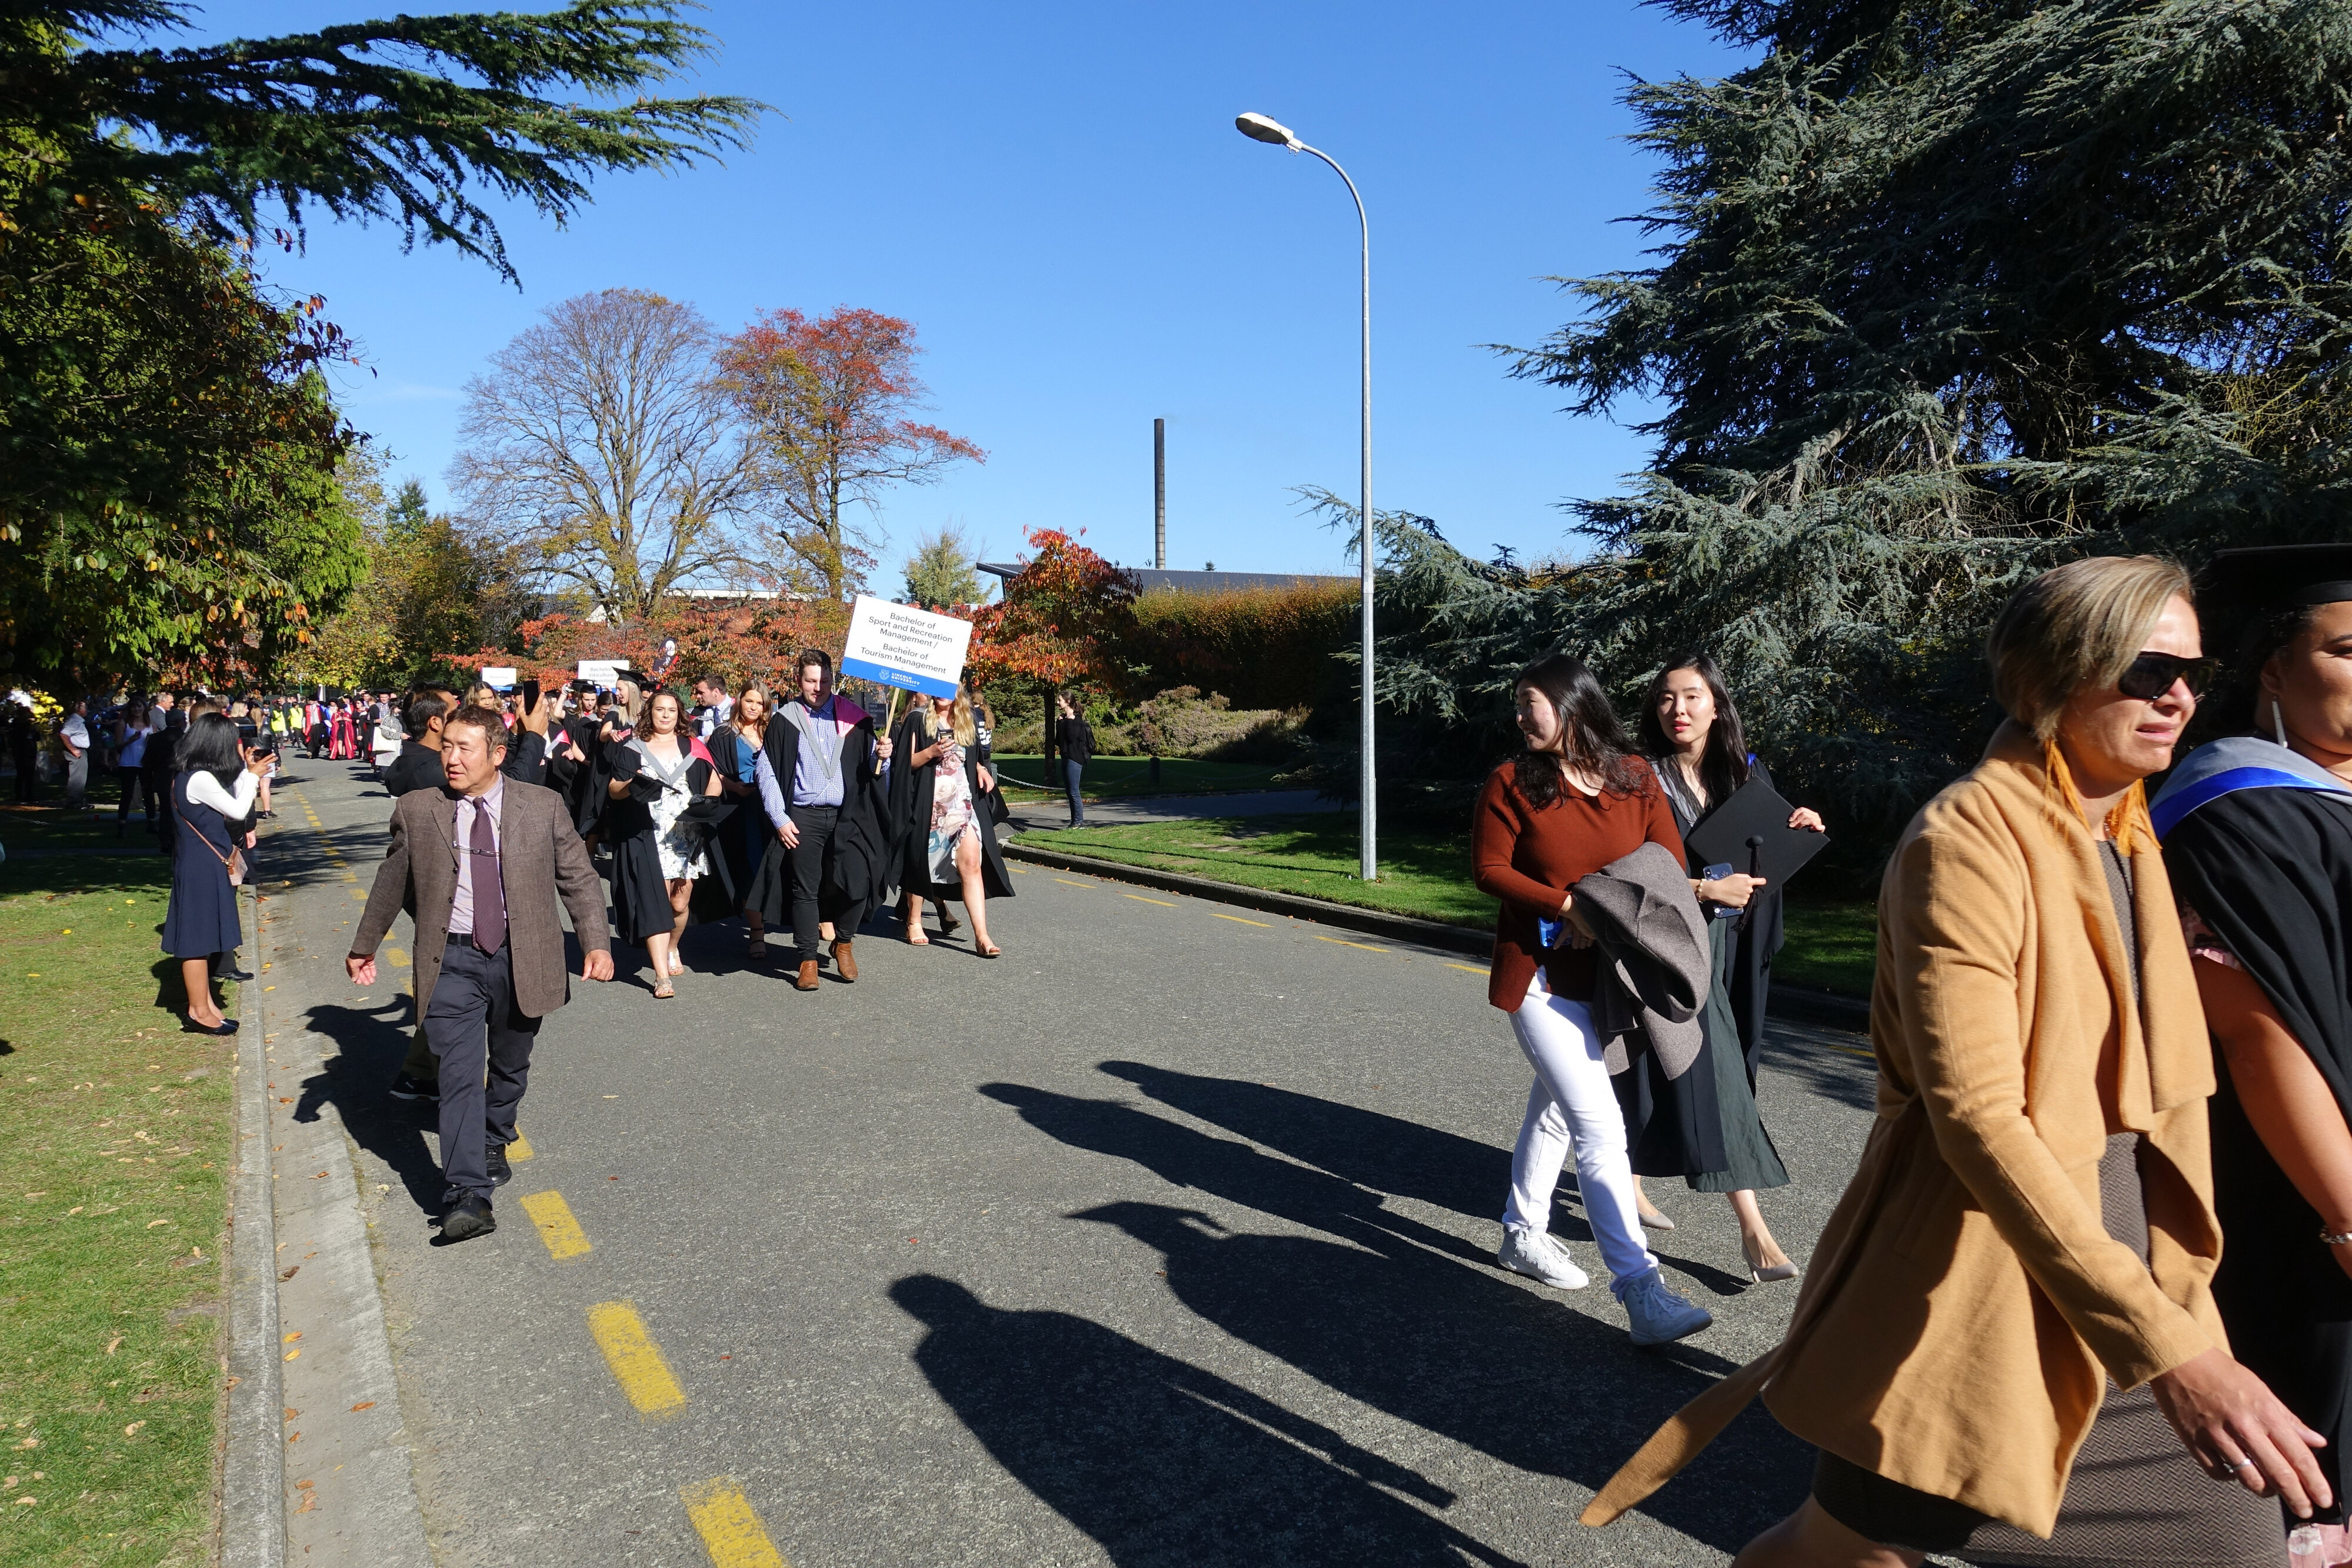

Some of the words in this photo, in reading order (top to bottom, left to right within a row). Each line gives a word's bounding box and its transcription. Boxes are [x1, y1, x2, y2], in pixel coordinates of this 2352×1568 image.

[890, 612, 925, 628] Bachelor
[869, 616, 891, 628] Sport
[892, 623, 908, 632] and
[910, 627, 952, 643] Recreation
[880, 628, 932, 647] Management
[883, 643, 918, 658] Bachelor
[861, 647, 892, 660] Tourism
[894, 655, 946, 674] Management
[891, 675, 920, 686] UNIVERSITY
